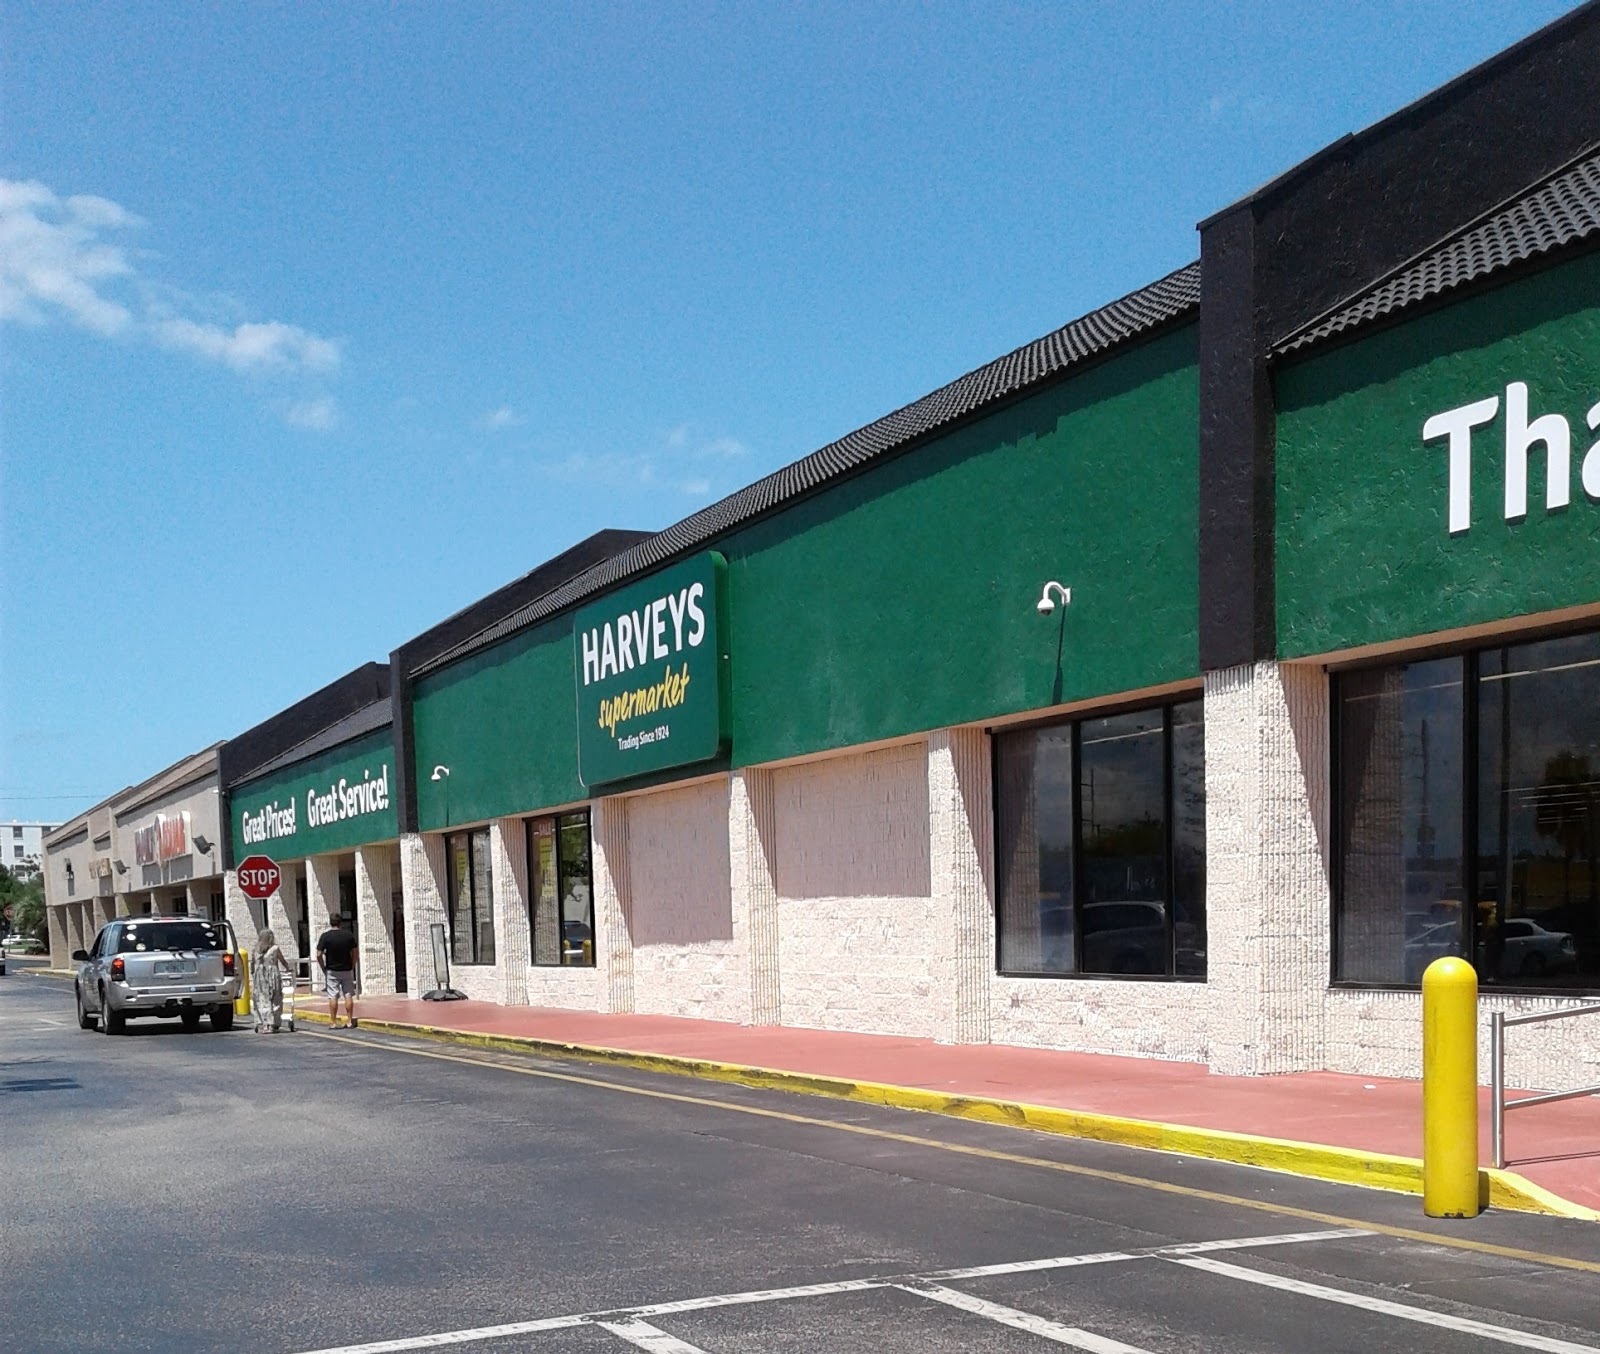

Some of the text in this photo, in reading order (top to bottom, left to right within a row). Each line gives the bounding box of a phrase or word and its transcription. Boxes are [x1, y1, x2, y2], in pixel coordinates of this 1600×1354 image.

[582, 582, 706, 686] HARVEYS
[598, 662, 690, 738] supermarket
[618, 724, 670, 750] Trading Since 1924
[242, 811, 267, 845] Great
[266, 796, 297, 839] Prices!
[307, 785, 339, 828] Great
[338, 764, 389, 820] Service!
[240, 869, 278, 886] STOP
